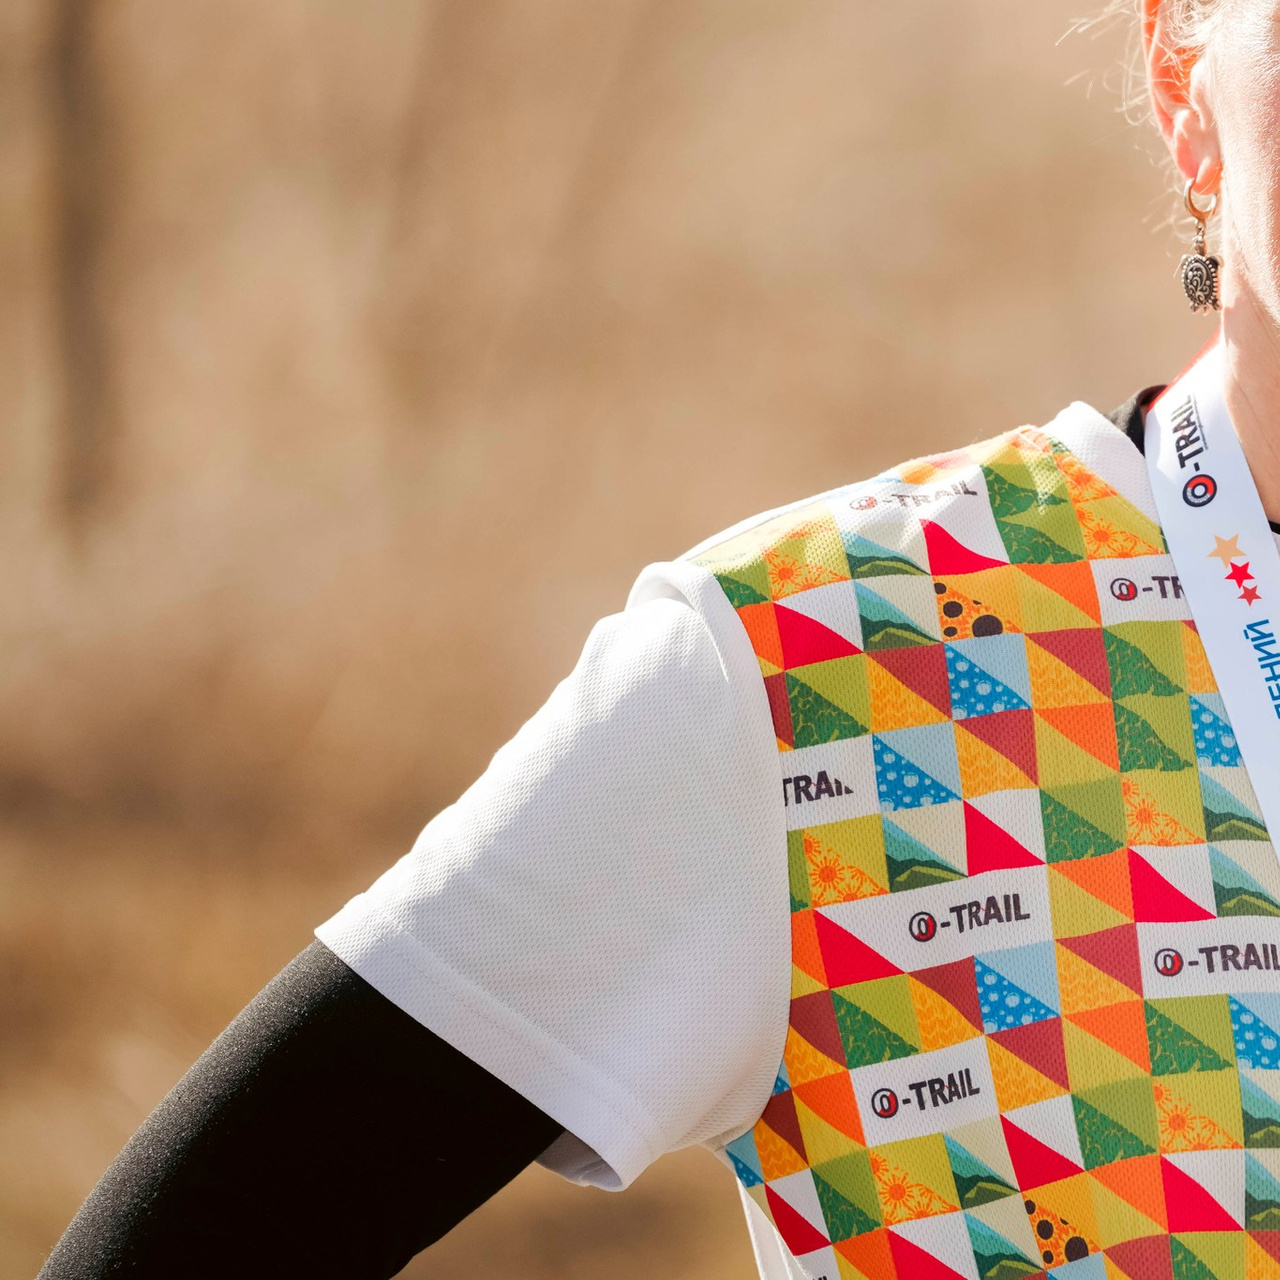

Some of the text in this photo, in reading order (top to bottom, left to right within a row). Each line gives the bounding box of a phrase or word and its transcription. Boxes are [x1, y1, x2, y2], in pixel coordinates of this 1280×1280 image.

[1171, 394, 1217, 507] O-TRAIL
[909, 893, 1031, 943] O-TRAIL
[871, 1067, 981, 1119] O-TRAIL
